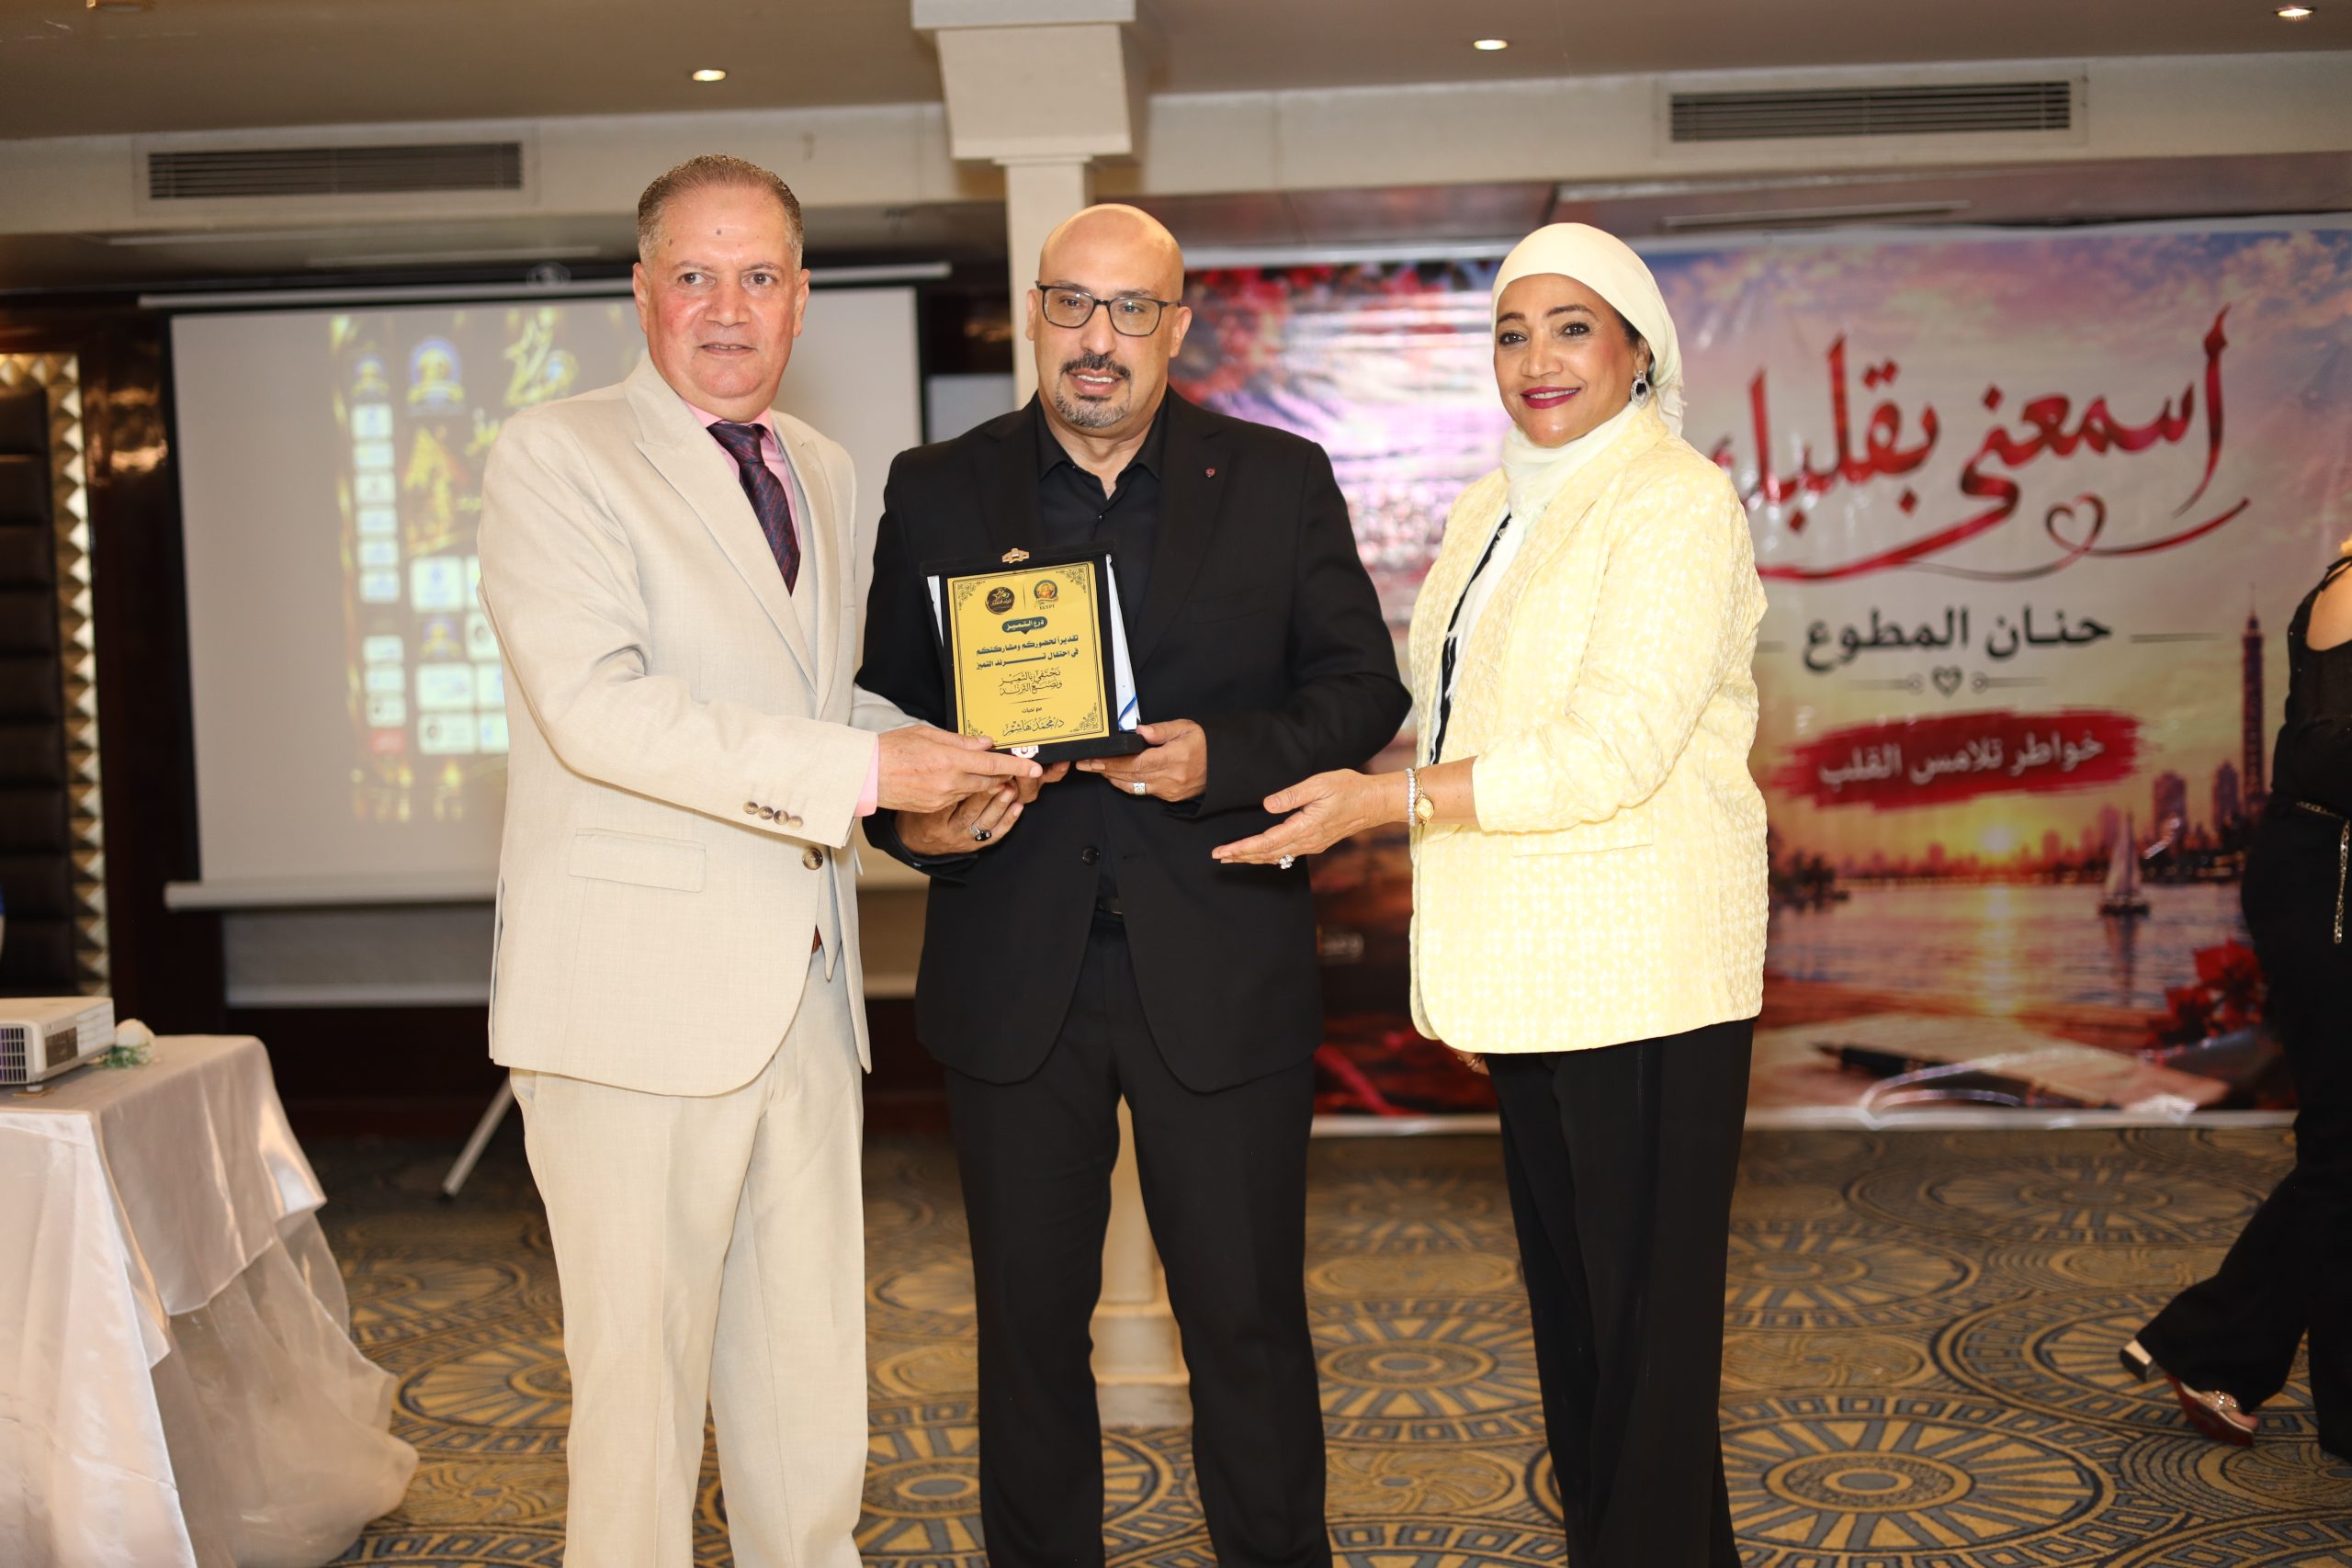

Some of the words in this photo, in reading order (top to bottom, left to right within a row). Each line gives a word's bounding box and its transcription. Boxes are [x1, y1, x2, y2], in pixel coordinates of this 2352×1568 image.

[1006, 620, 1034, 631] التميز
[1034, 619, 1045, 628] درع
[1985, 604, 2113, 660] حنان
[1022, 637, 1057, 650] لحضوركم
[1803, 605, 1970, 673] المطوع
[976, 643, 1021, 656] ومشاركتكم
[1070, 647, 1080, 658] في
[977, 660, 993, 670] التميز
[2009, 729, 2105, 777] خواطر
[1909, 736, 2005, 785] تلامس
[1818, 743, 1904, 793] القلب
